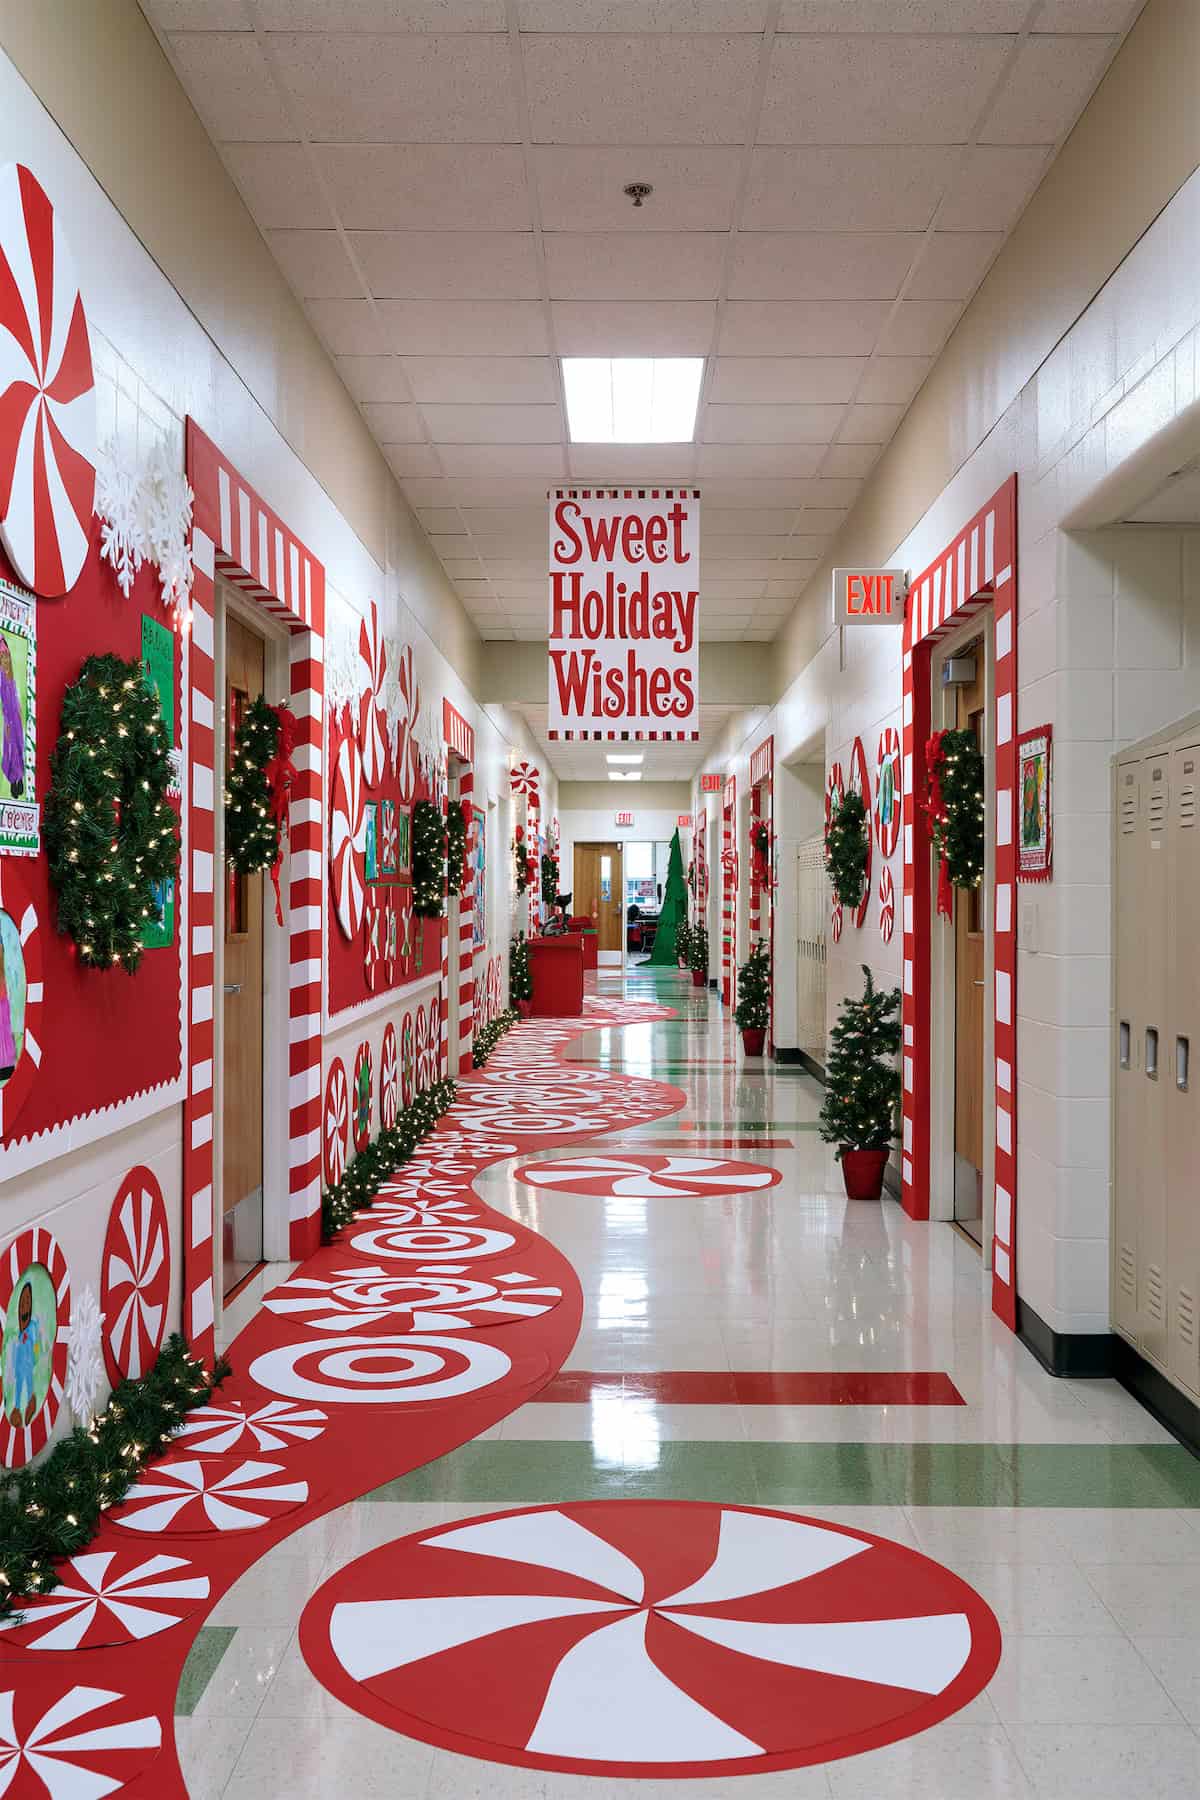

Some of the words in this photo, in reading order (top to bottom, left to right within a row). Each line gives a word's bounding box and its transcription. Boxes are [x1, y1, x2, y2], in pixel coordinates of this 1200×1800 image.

[553, 501, 690, 564] Sweet
[549, 571, 699, 653] Holiday
[847, 575, 894, 615] EXIT
[548, 649, 694, 718] Wishes
[702, 775, 720, 791] EXIT
[618, 813, 632, 824] EXIT
